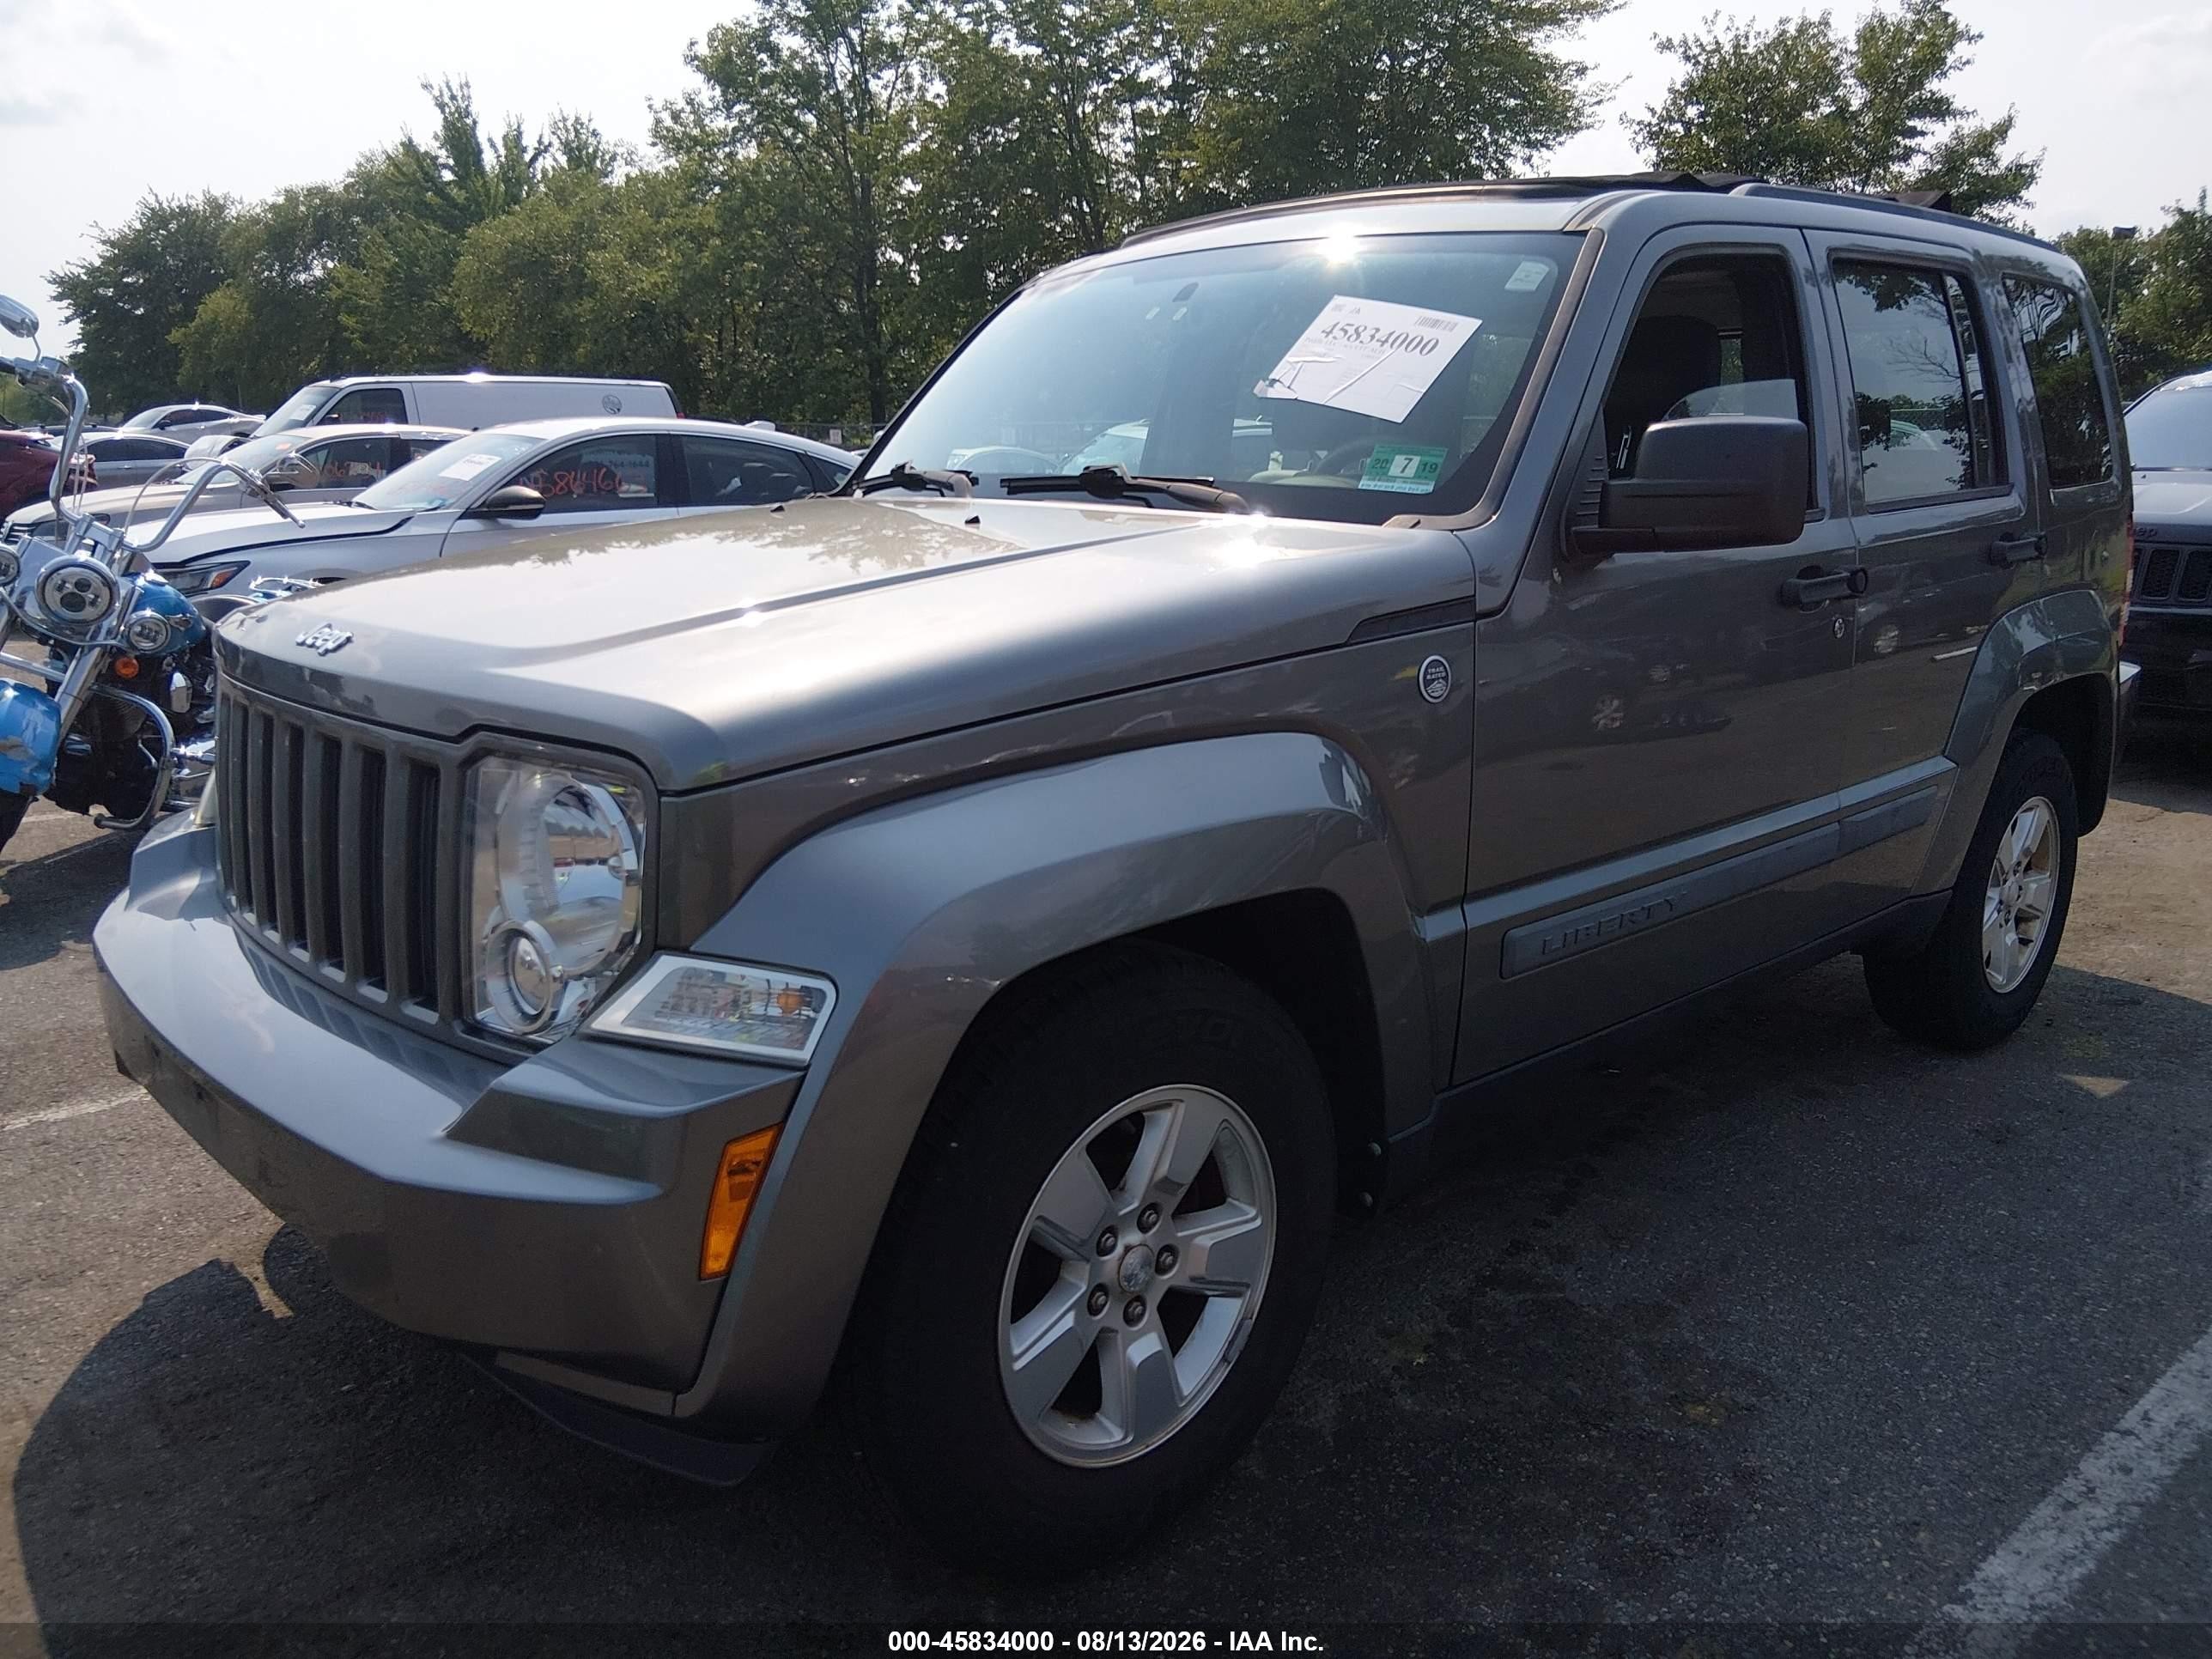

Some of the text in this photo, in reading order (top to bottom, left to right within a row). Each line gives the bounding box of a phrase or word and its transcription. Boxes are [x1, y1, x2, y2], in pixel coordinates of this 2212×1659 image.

[1321, 321, 1440, 357] 45834000
[1372, 457, 1438, 474] 20 7 19
[295, 623, 354, 657] Jeep
[1541, 891, 1687, 956] LIBERTY
